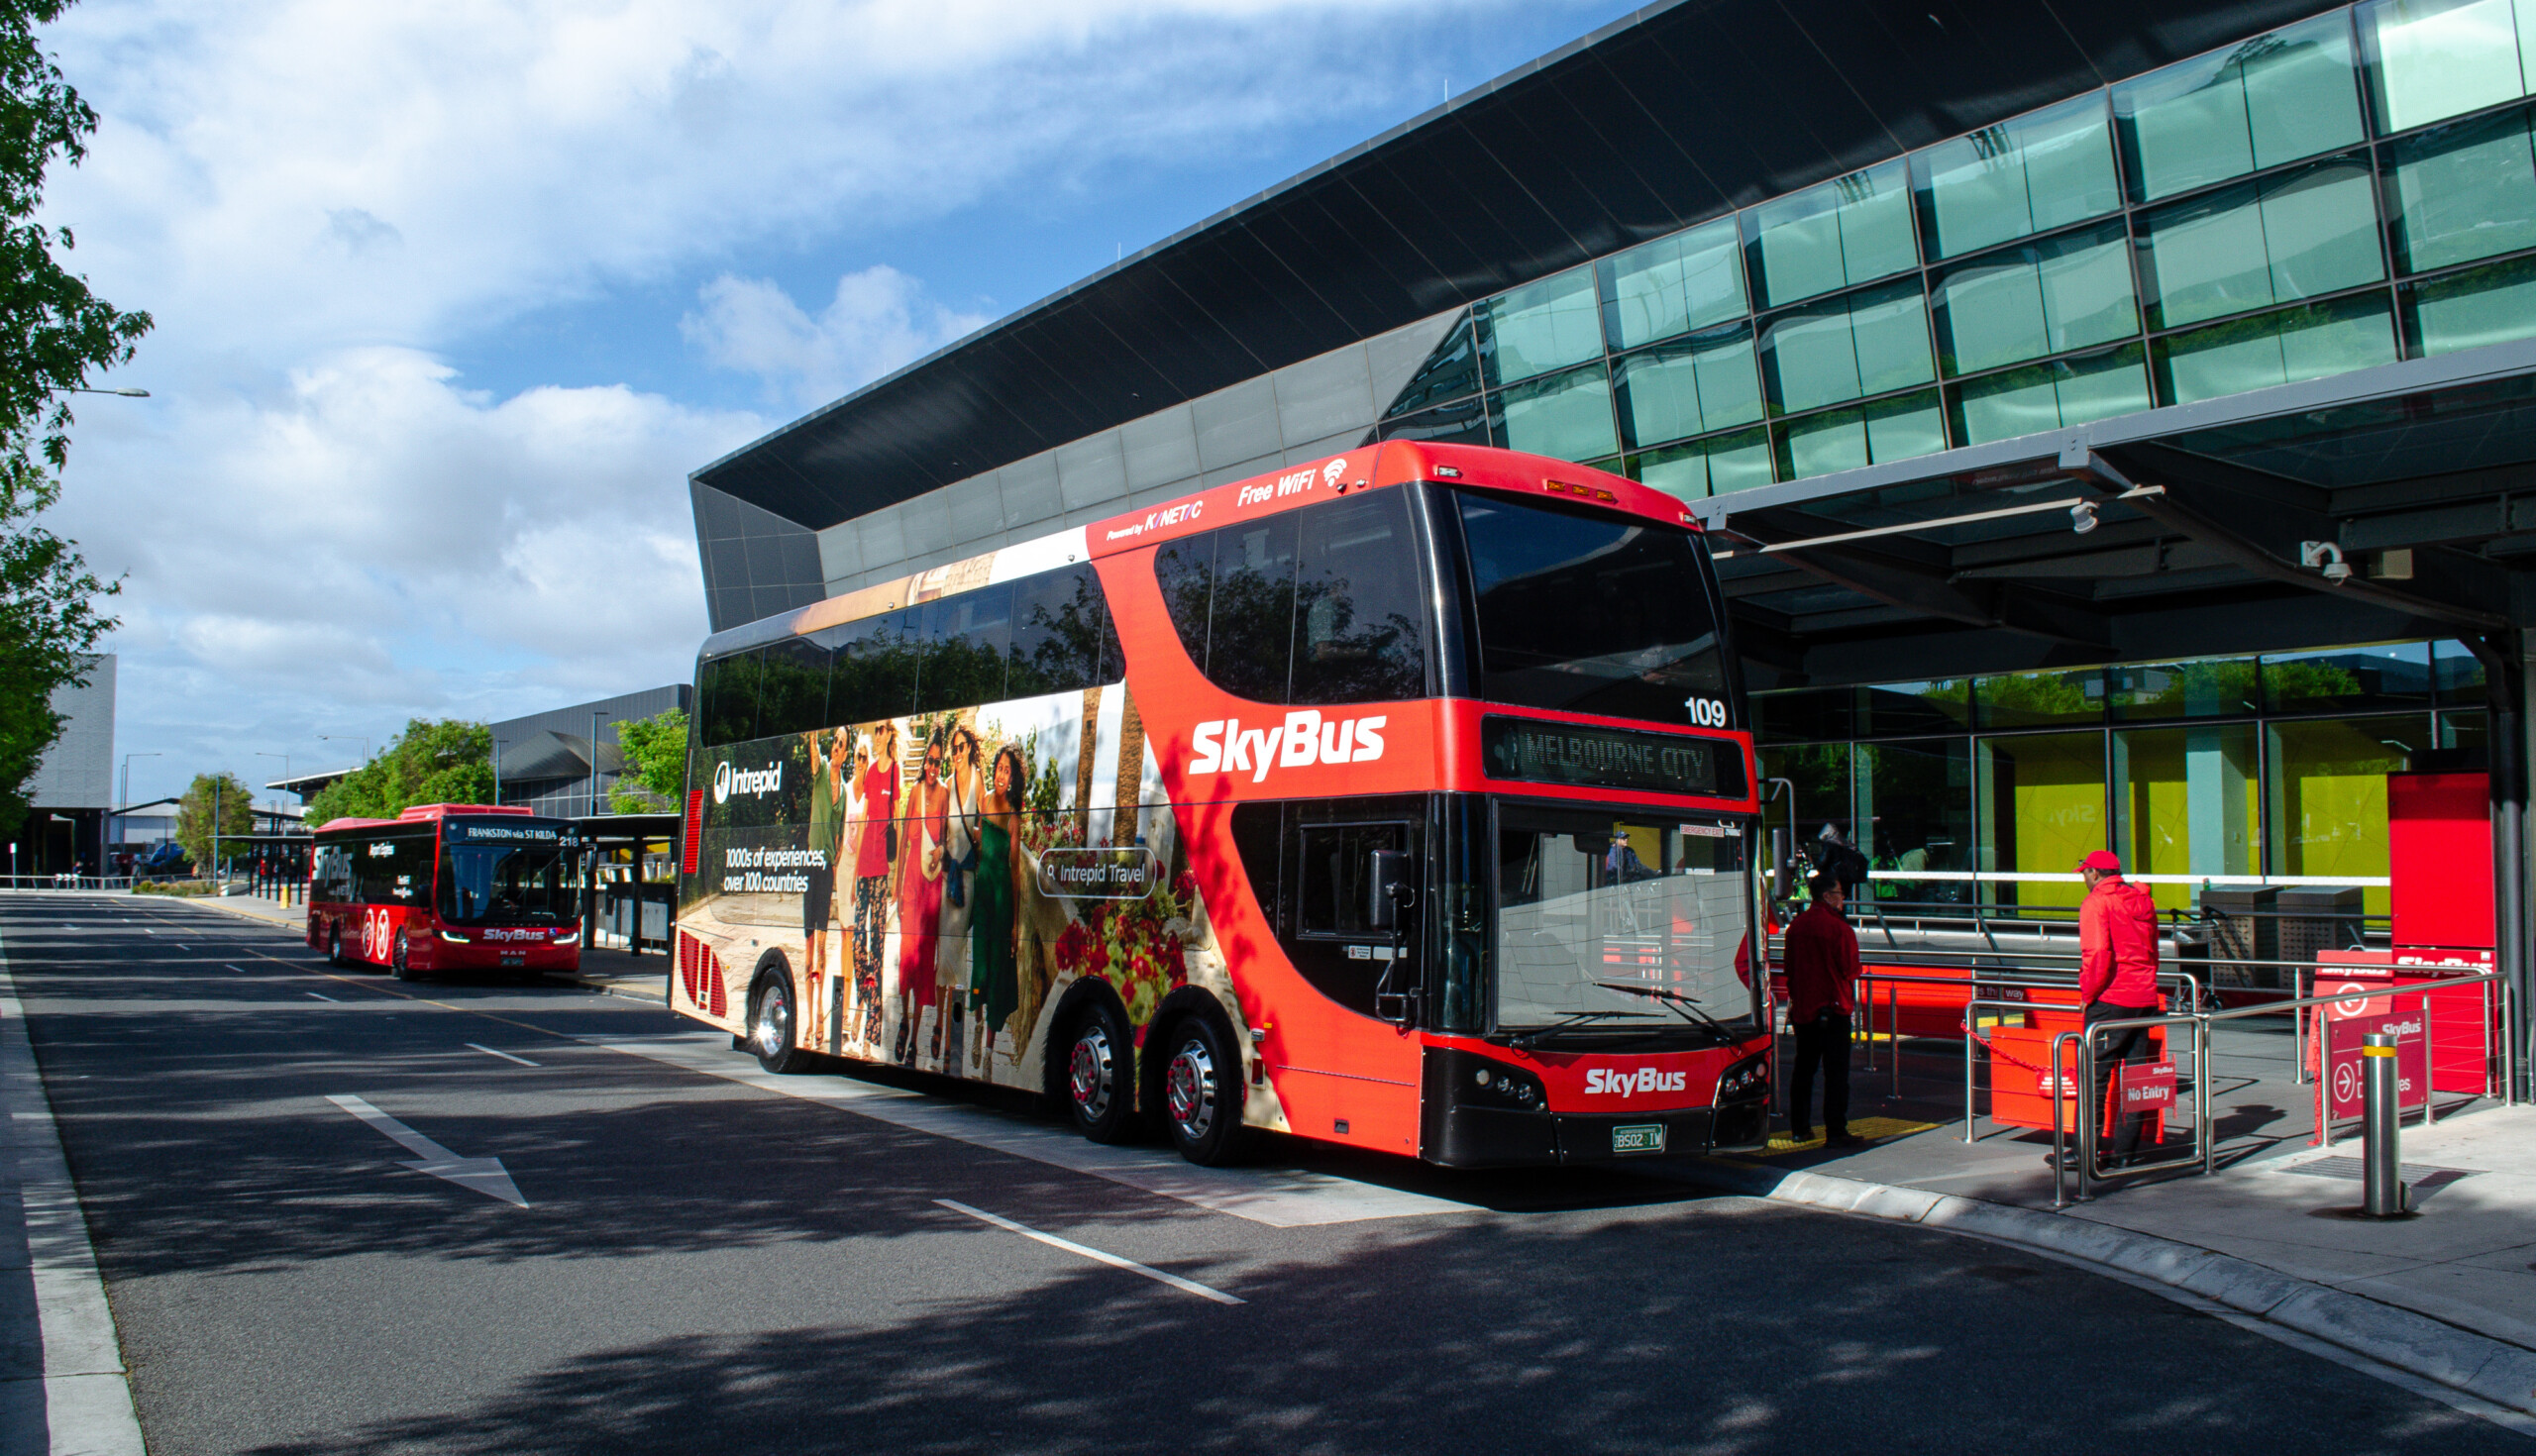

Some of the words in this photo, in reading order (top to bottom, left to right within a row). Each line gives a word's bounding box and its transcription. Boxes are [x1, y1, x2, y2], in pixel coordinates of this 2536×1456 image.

[1237, 484, 1273, 507] Free
[1277, 468, 1317, 497] WiFi
[1107, 527, 1135, 541] Powered
[1135, 524, 1143, 536] by
[1685, 696, 1726, 727] 109
[1189, 710, 1387, 782] SkyBus
[1527, 733, 1654, 775] MELBOURNE
[1660, 747, 1704, 779] CITY
[731, 761, 783, 799] Intrepid
[468, 827, 512, 838] FRANKSTON
[512, 830, 523, 839] via
[524, 830, 534, 839] ST
[535, 830, 557, 840] KILDA
[1680, 824, 1711, 835] EMERGENCY
[1712, 827, 1723, 836] EXIT
[559, 837, 579, 847] 218
[312, 845, 353, 887] SkyBus
[726, 848, 752, 868] 1000s
[753, 846, 765, 868] of
[765, 844, 827, 872] experiences,
[724, 876, 744, 891] over
[745, 872, 762, 890] 100
[762, 870, 808, 891] countries
[1060, 863, 1106, 886] Intrepid
[1109, 863, 1145, 883] Travel
[483, 929, 545, 942] SkyBus
[2005, 989, 2024, 1000] way
[2382, 1021, 2421, 1037] SkyBus
[1585, 1068, 1686, 1097] SkyBus
[2128, 1088, 2141, 1101] No
[2143, 1086, 2169, 1100] Entry
